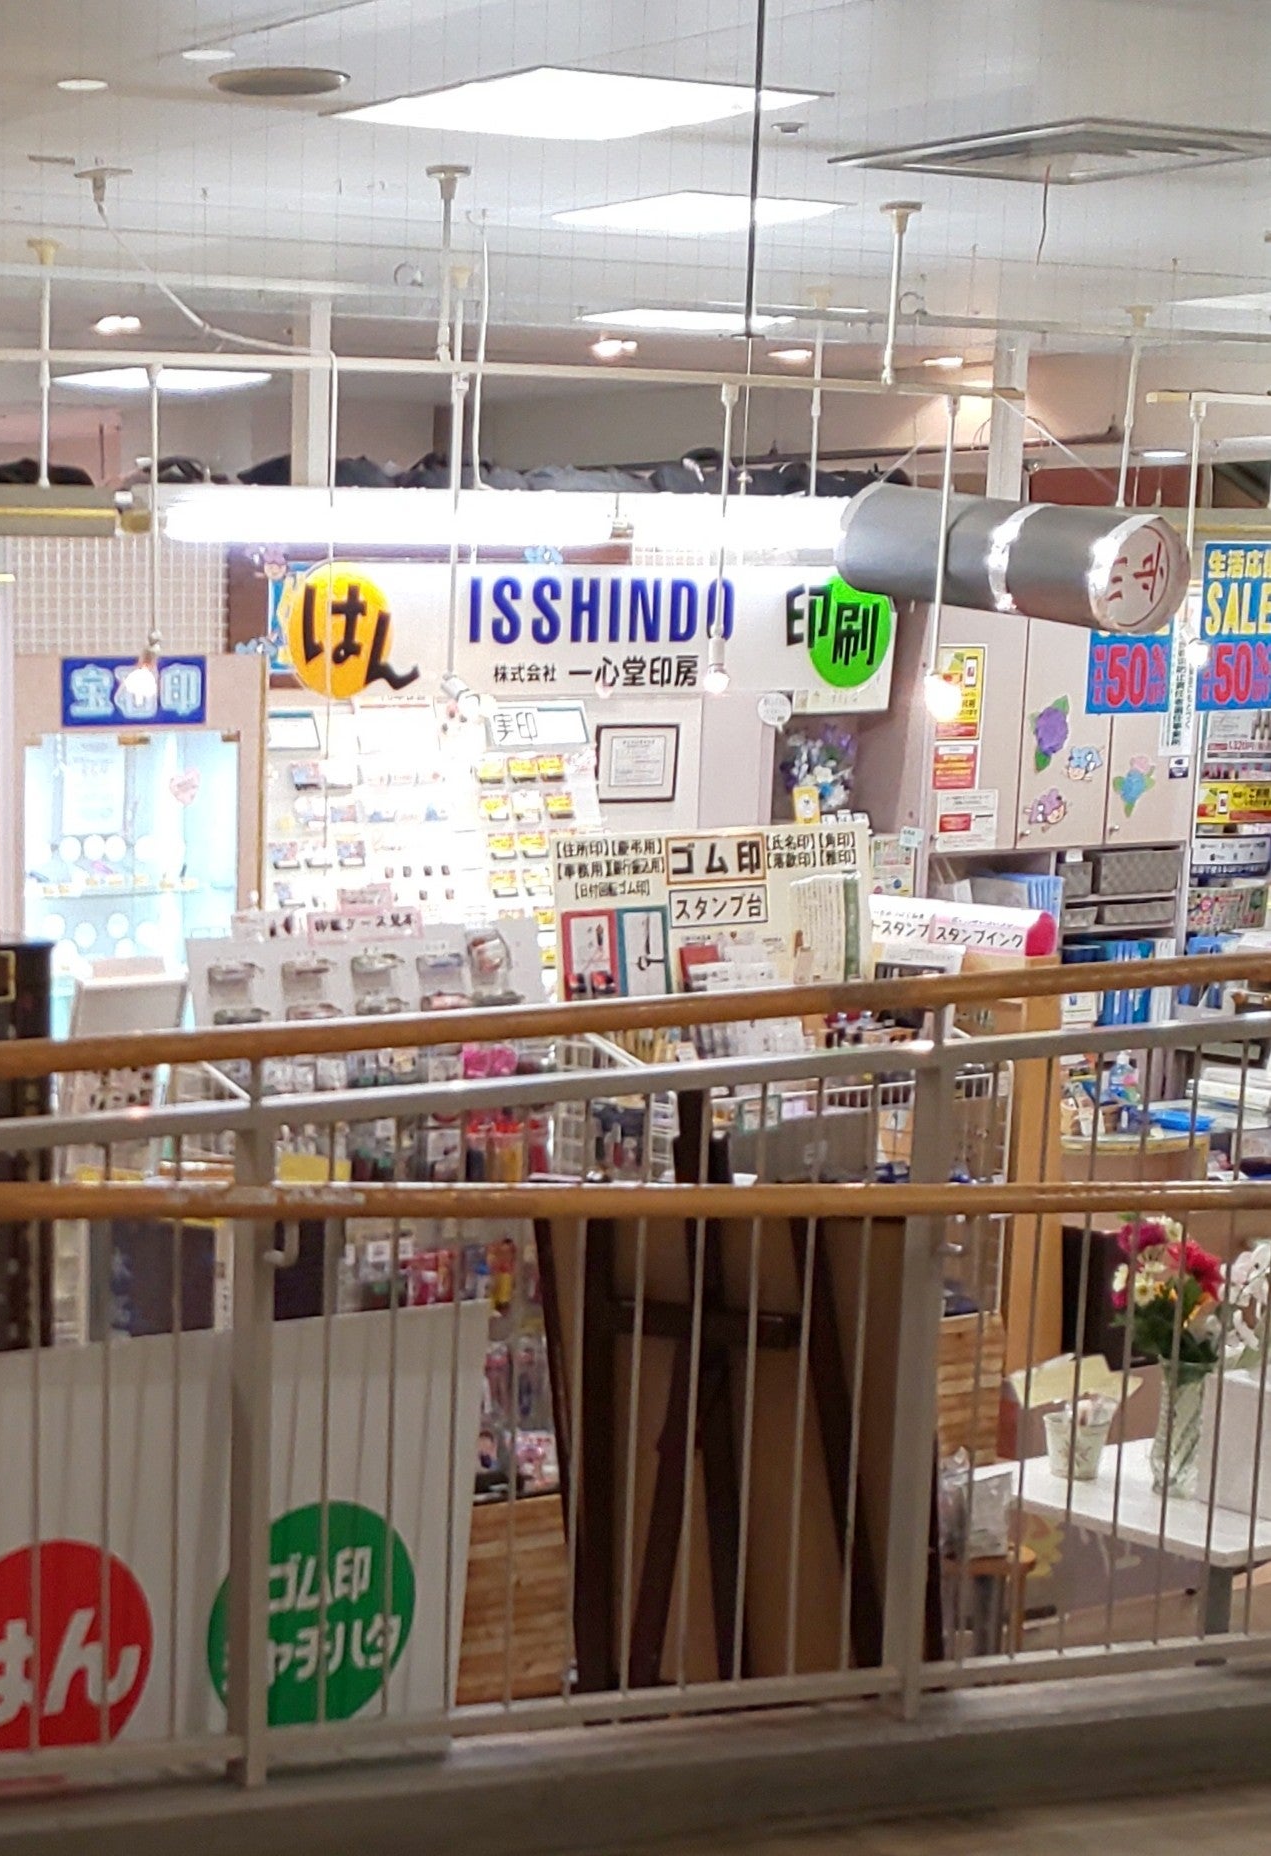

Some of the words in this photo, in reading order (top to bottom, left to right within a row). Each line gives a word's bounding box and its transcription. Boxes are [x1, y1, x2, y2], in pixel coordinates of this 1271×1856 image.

[301, 584, 420, 691] はん
[468, 576, 736, 645] ISSHINDO
[785, 582, 880, 667] 印刷
[1205, 581, 1271, 636] SALE
[493, 662, 558, 684] 株式会社
[568, 655, 699, 688] 一心堂印房
[671, 841, 761, 877] ゴム印
[675, 893, 762, 920] スタンプ台
[936, 926, 1024, 949] スタンプインク
[268, 1546, 373, 1613] ゴム印
[222, 1613, 403, 1692] ャチハタ
